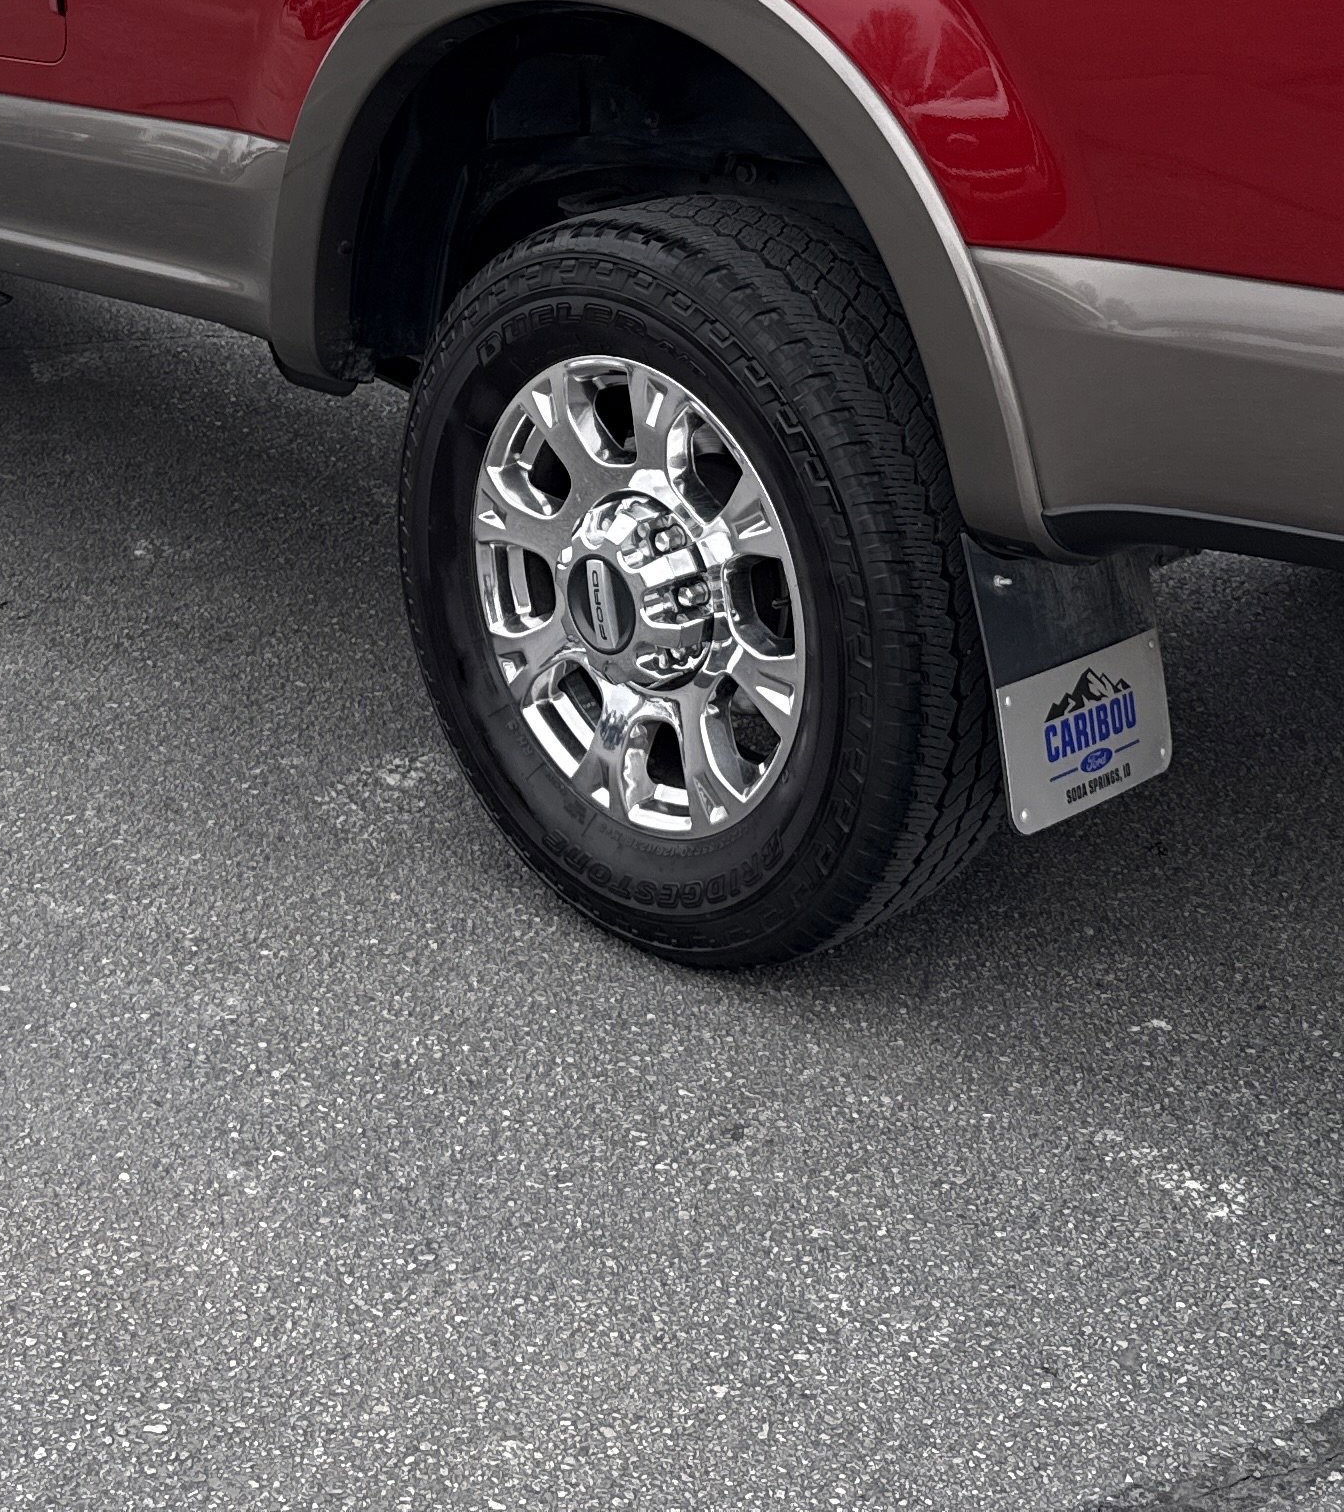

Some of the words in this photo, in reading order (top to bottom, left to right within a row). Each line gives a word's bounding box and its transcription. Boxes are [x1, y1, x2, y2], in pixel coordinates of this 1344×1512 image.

[476, 301, 648, 368] DUELER
[592, 569, 609, 641] FORD
[1044, 691, 1136, 763] CARIBOU
[1066, 783, 1088, 804] SODA
[1088, 768, 1123, 795] SPRINGS,
[542, 828, 785, 909] BRIDGESTONE
